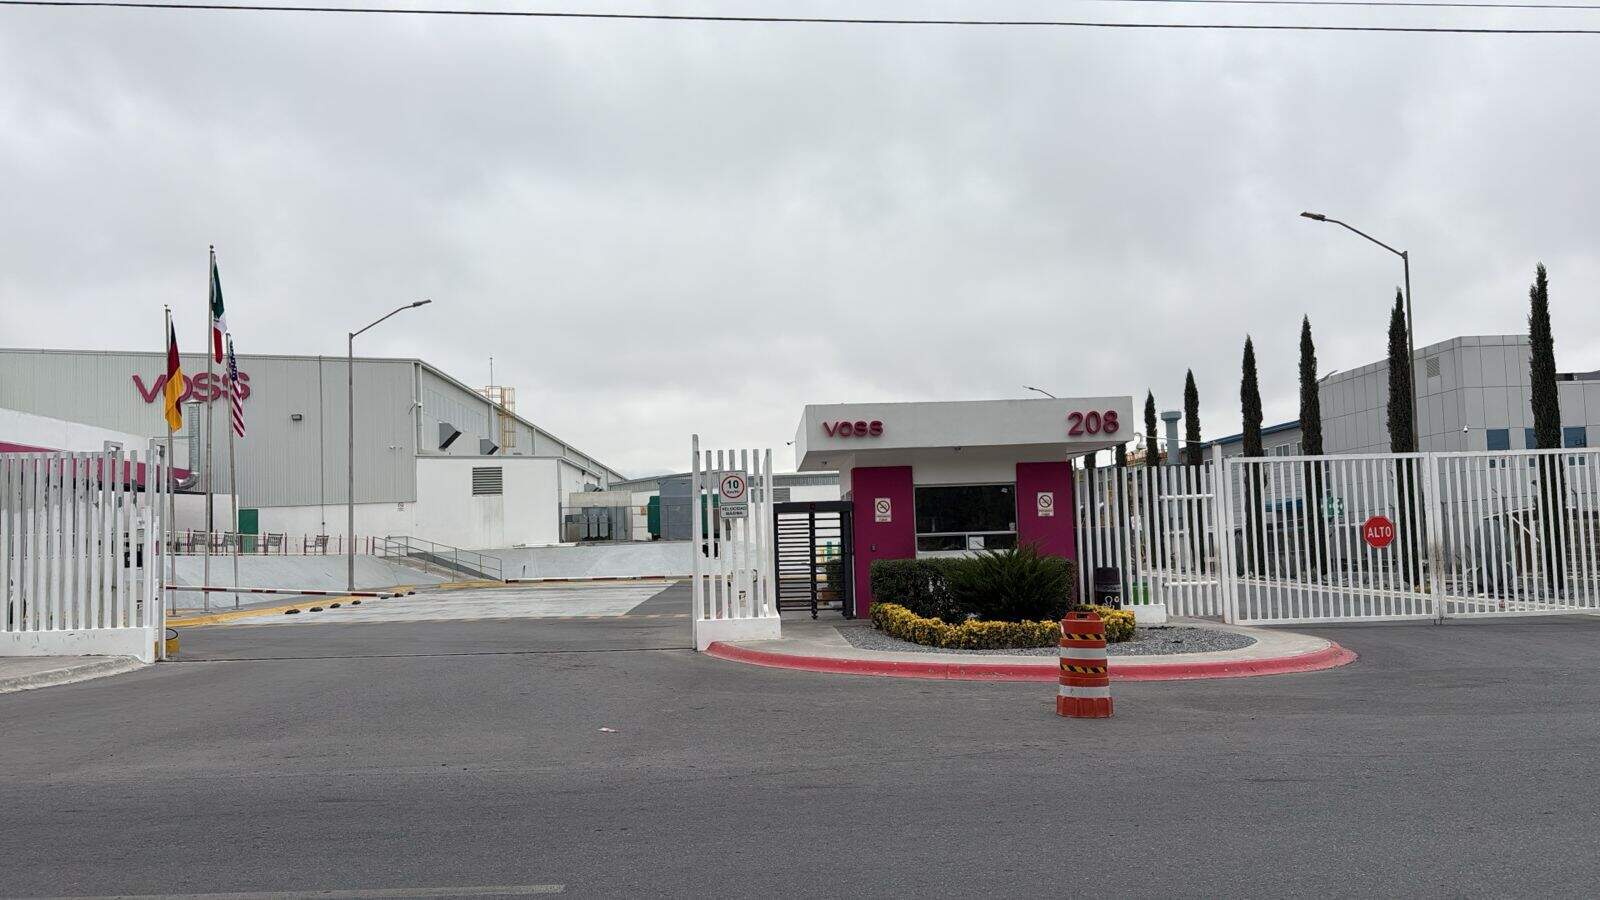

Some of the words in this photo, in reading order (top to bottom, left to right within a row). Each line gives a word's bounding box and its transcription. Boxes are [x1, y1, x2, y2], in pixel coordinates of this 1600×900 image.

[823, 420, 884, 437] VOSS
[1067, 410, 1120, 436] 208
[727, 480, 739, 489] 10
[1367, 526, 1392, 538] ALTO
